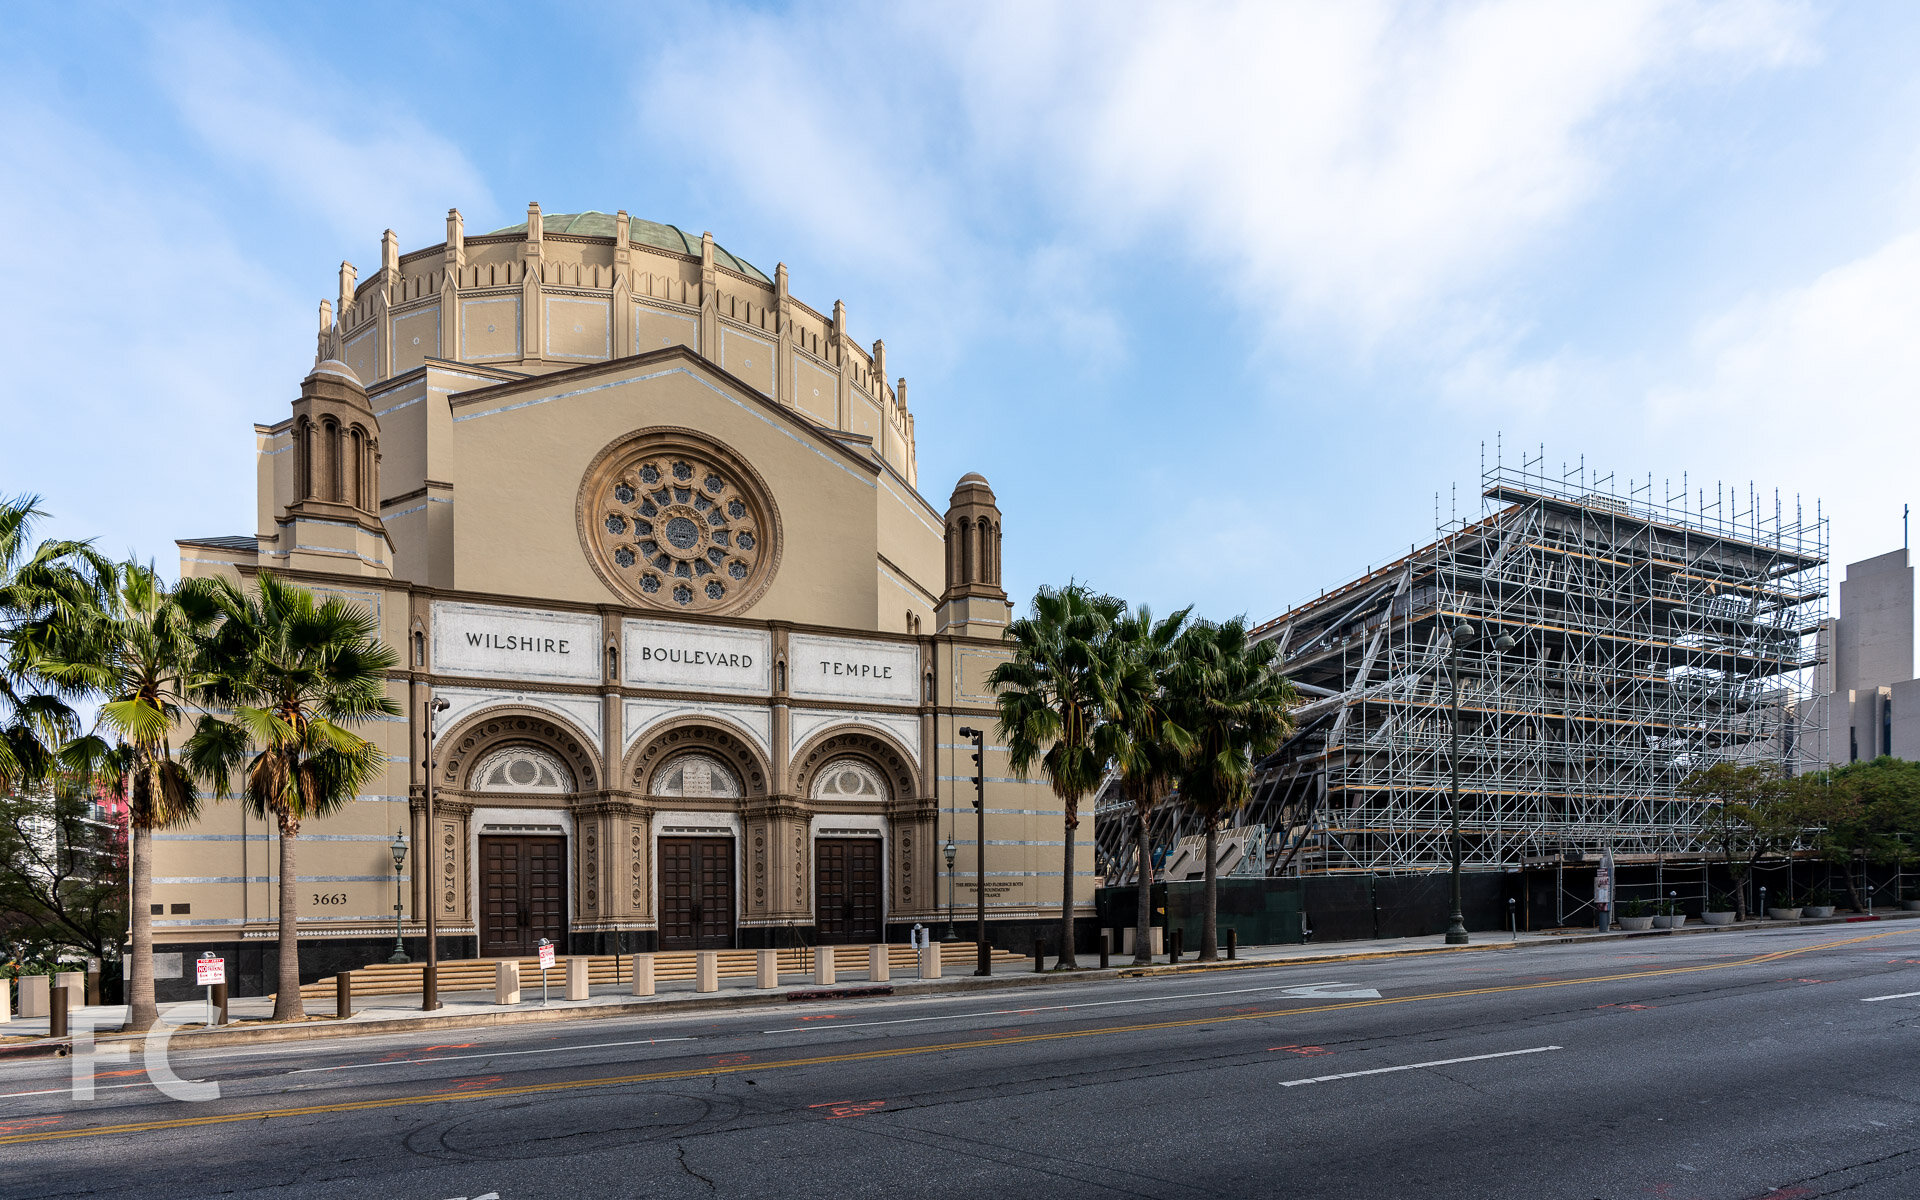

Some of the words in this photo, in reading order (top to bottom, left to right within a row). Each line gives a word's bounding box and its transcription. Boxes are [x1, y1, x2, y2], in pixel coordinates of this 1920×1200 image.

[466, 632, 570, 654] WILSHIRE
[642, 646, 752, 668] BOULEVARD
[820, 661, 893, 679] TEMPLE
[312, 893, 347, 905] 3663
